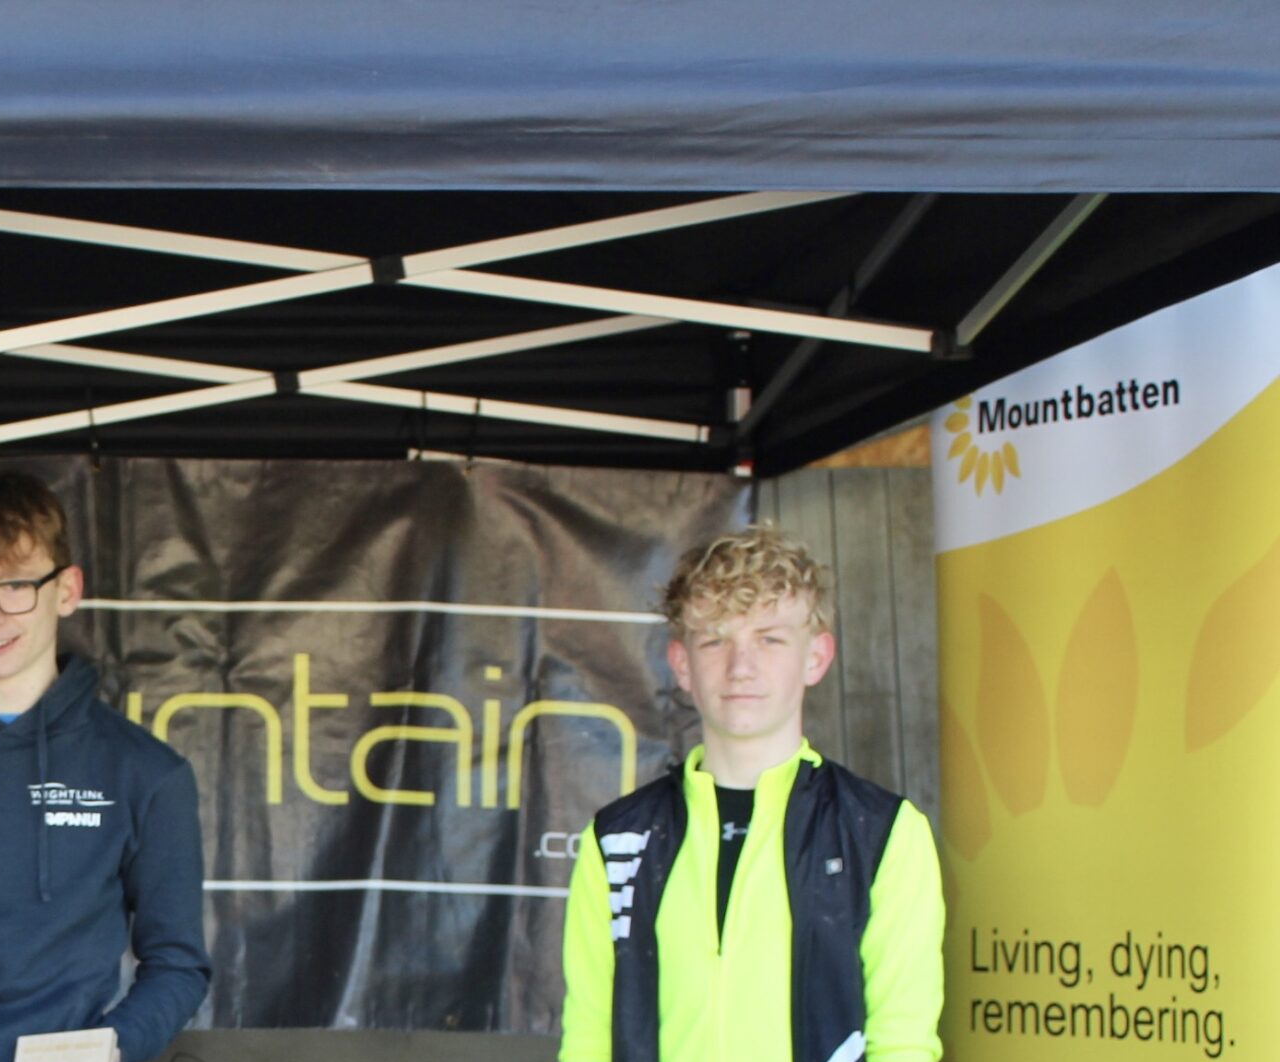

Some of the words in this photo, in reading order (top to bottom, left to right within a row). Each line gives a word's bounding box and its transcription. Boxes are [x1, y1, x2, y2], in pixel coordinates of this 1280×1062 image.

[978, 379, 1179, 433] Mountbatten
[971, 927, 1093, 987] Living,
[1111, 930, 1220, 993] dying,
[971, 993, 1234, 1058] remembering.
